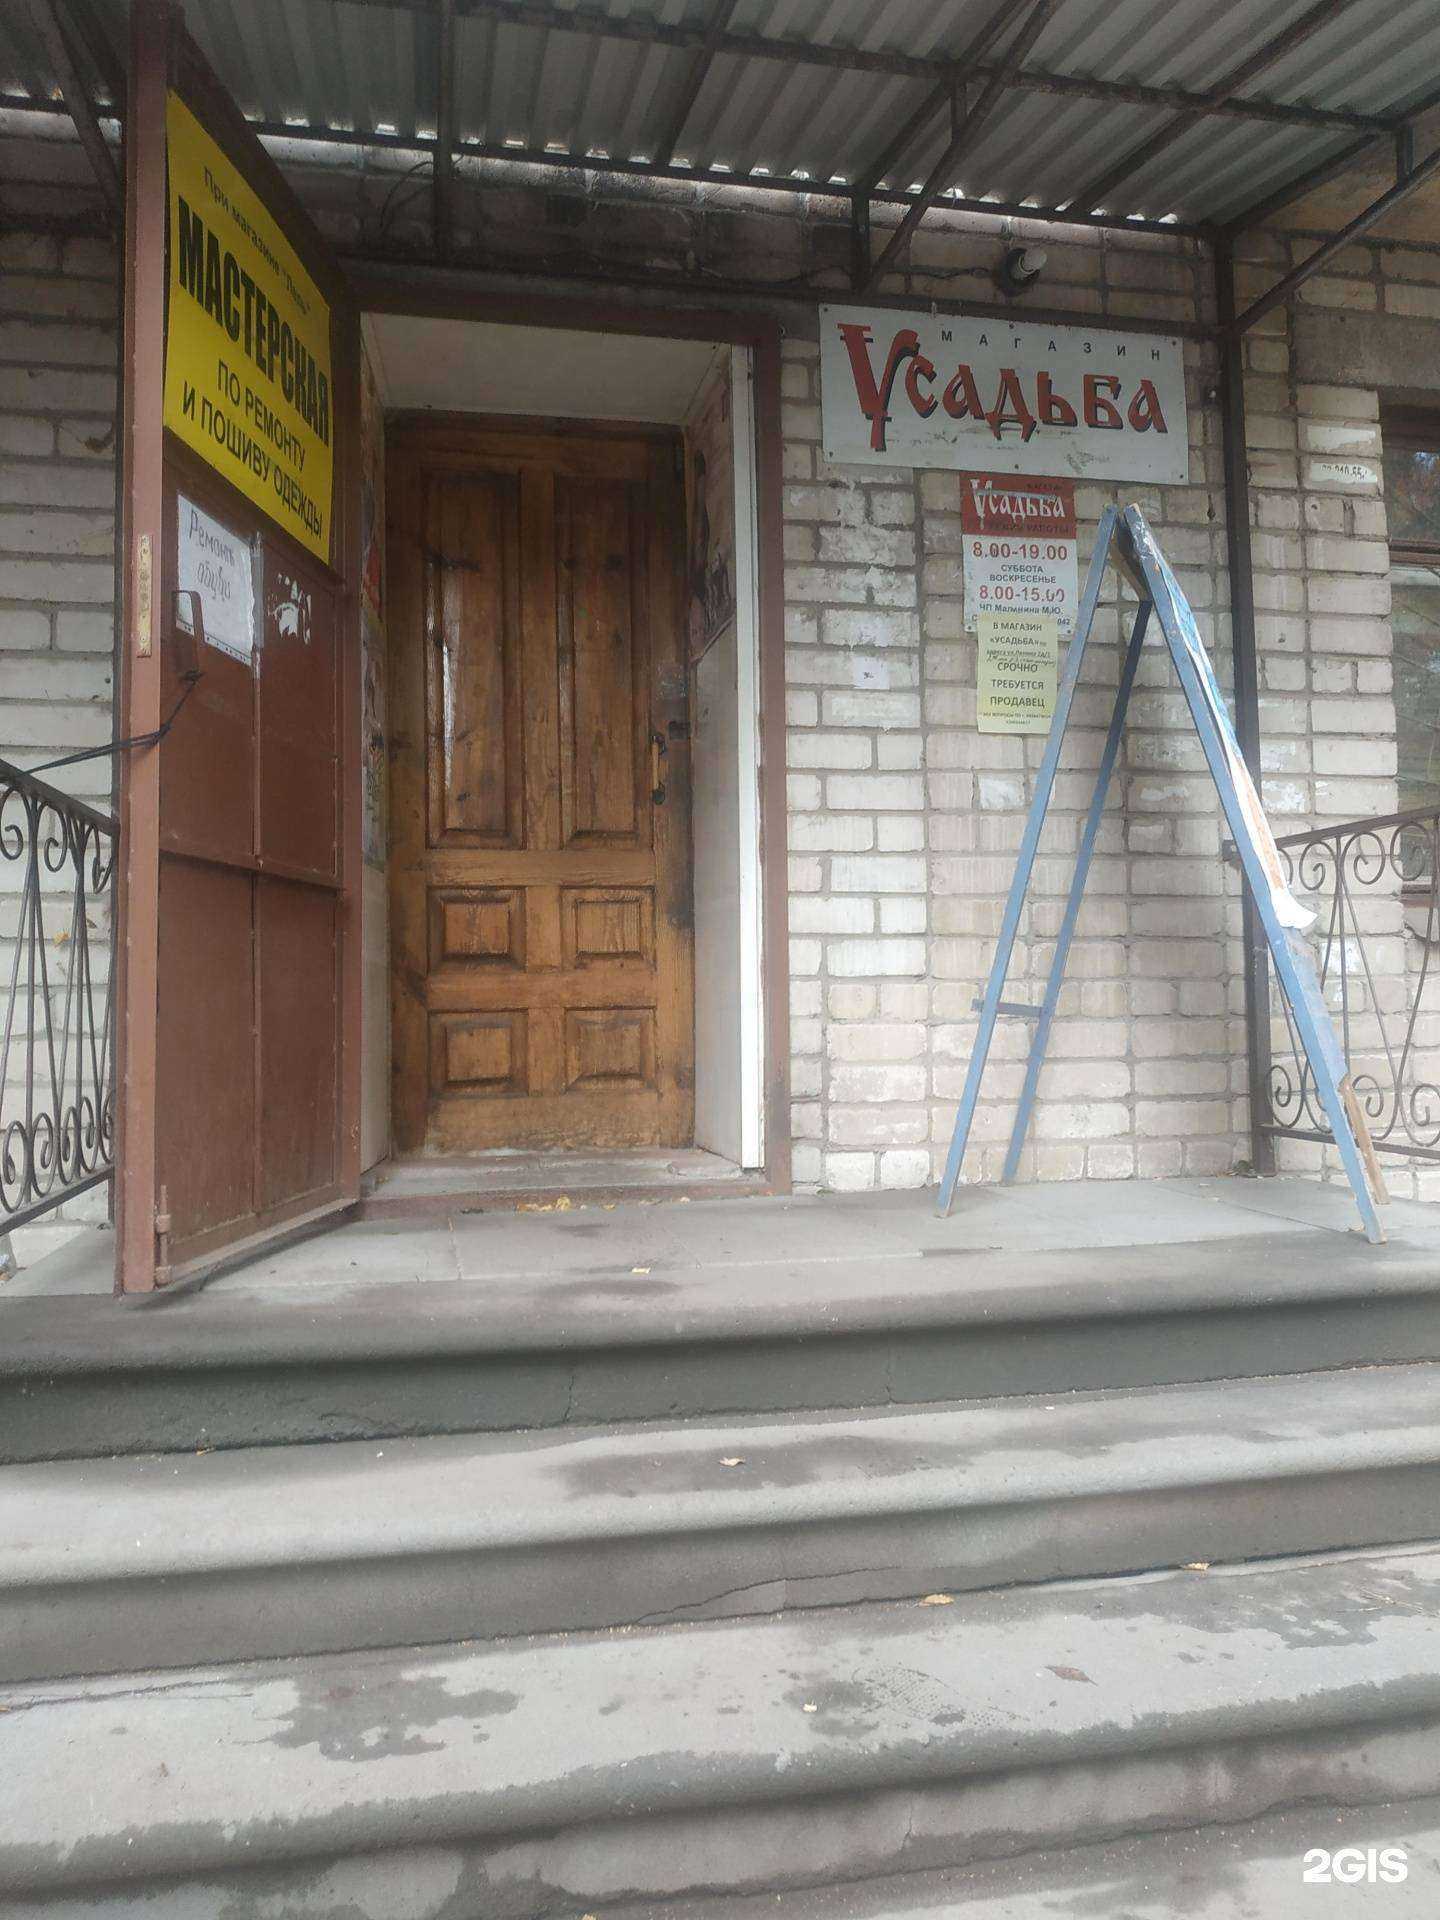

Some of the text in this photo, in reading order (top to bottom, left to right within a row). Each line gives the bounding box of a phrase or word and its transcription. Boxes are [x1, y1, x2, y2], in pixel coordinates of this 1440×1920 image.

[204, 166, 229, 213] При
[231, 206, 280, 275] магазине
[178, 194, 329, 448] МАСТЕРСКАЯ
[941, 330, 1160, 361] МАГАЗИН
[217, 358, 306, 472] ПО РЕМОНТУ
[182, 380, 323, 540] И ПОШИВУ ОДЕЖДЫ
[973, 541, 1068, 560] 8.00-19.00
[1000, 564, 1044, 574] СУББОТА
[989, 574, 1057, 584] ВОСКРЕСЕНЬЕ
[979, 584, 1065, 603] 8.00-15.00
[979, 604, 992, 612] ЧП
[993, 622, 1042, 631] В МАГАЗИН
[997, 662, 1038, 673] СРОЧНО
[992, 679, 1044, 690] ТРЕБУЕТСЯ
[990, 696, 1045, 708] ПРОДАВЕЦ
